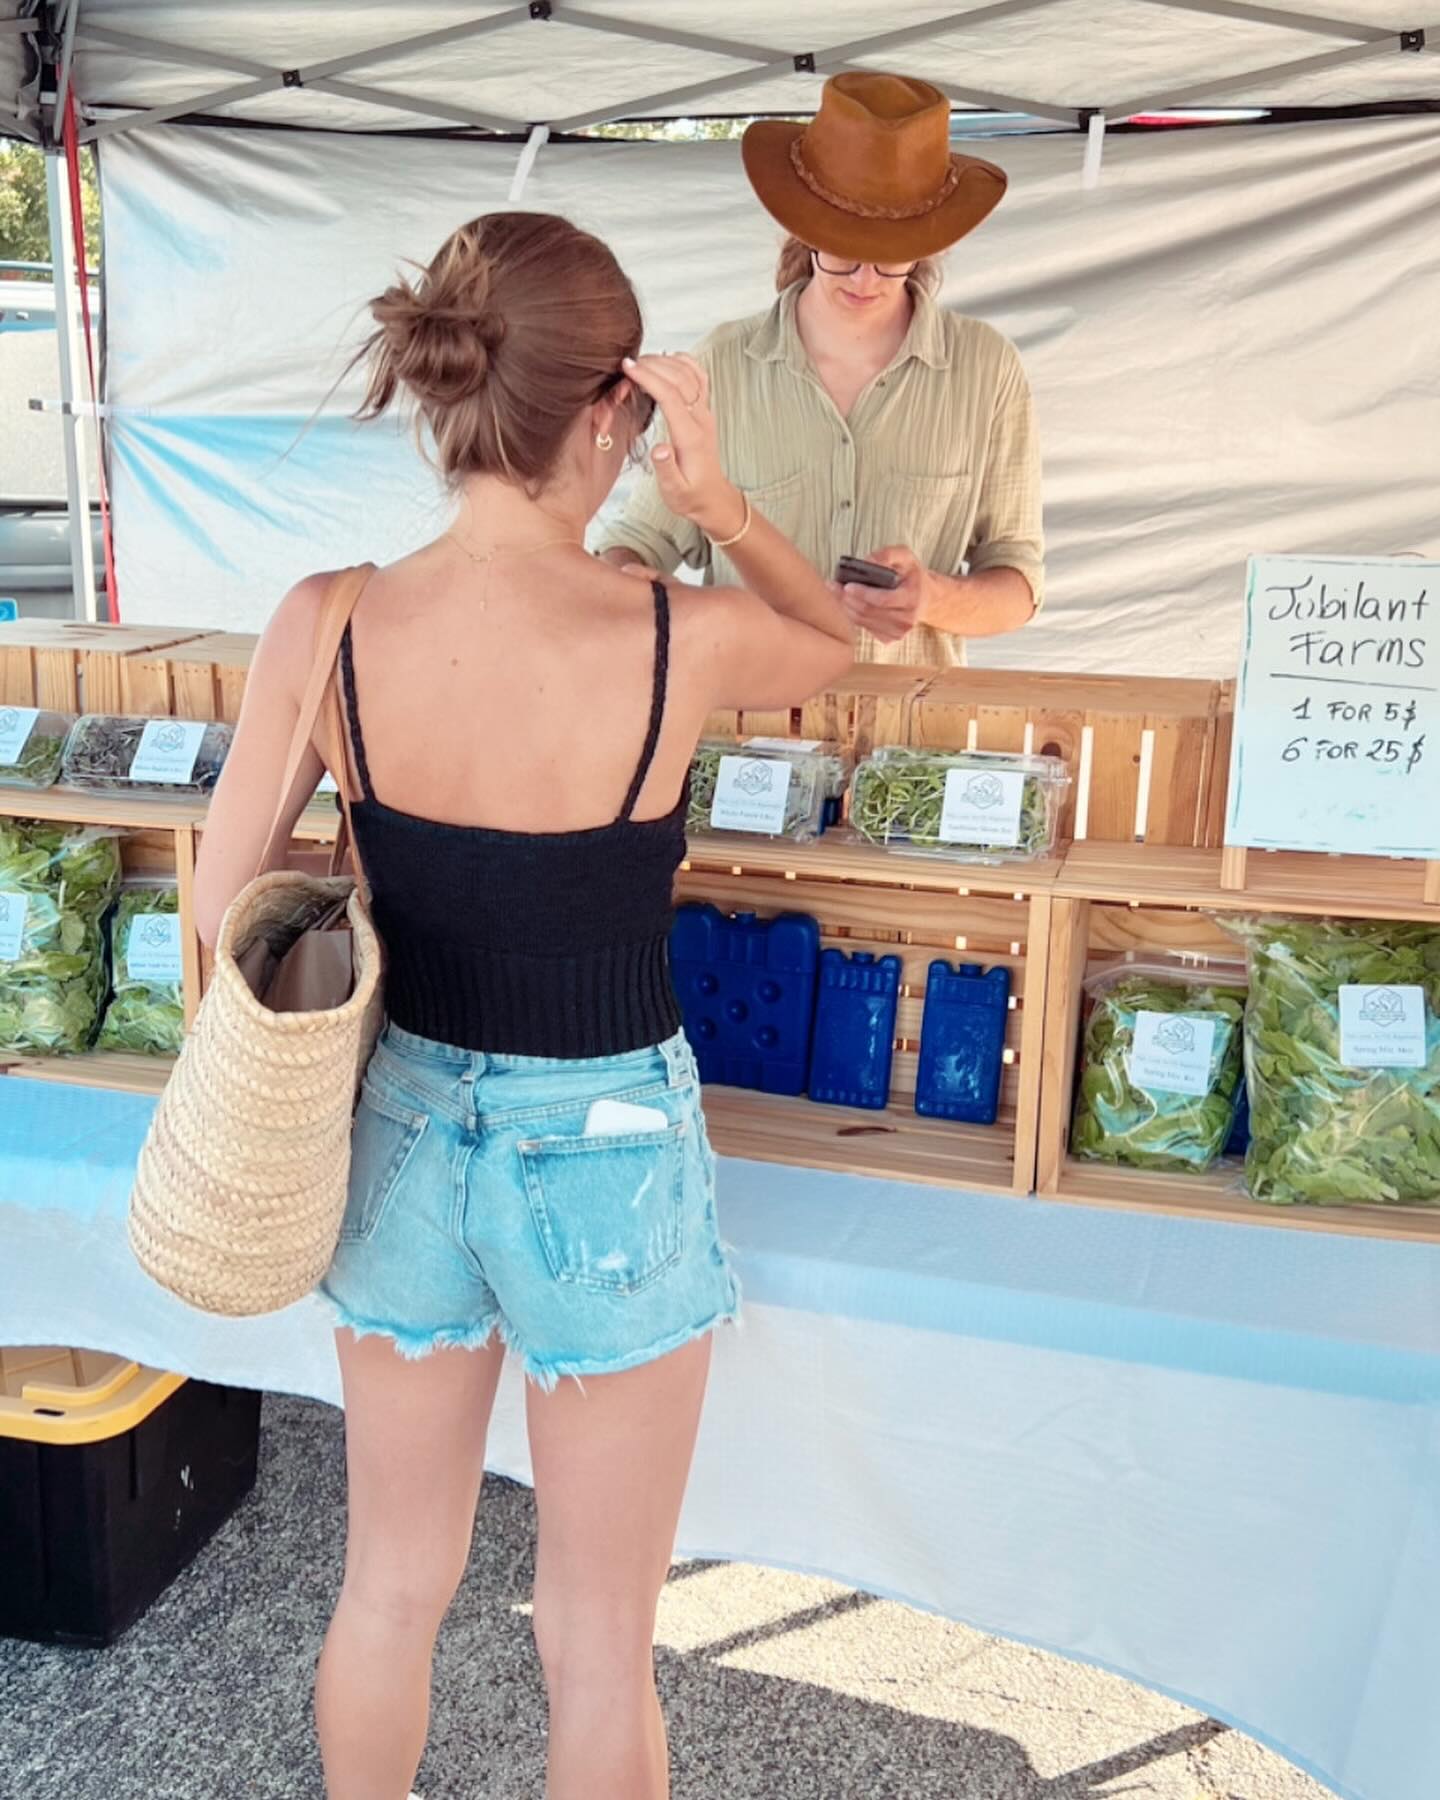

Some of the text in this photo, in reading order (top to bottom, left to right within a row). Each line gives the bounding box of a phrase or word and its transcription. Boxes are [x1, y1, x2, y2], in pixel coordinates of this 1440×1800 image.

[1265, 575, 1430, 622] Jubilant
[1289, 630, 1427, 668] Farms
[1292, 697, 1312, 720] 1
[1327, 701, 1372, 722] FOR
[1282, 737, 1308, 762] 6
[1315, 739, 1359, 760] FOR
